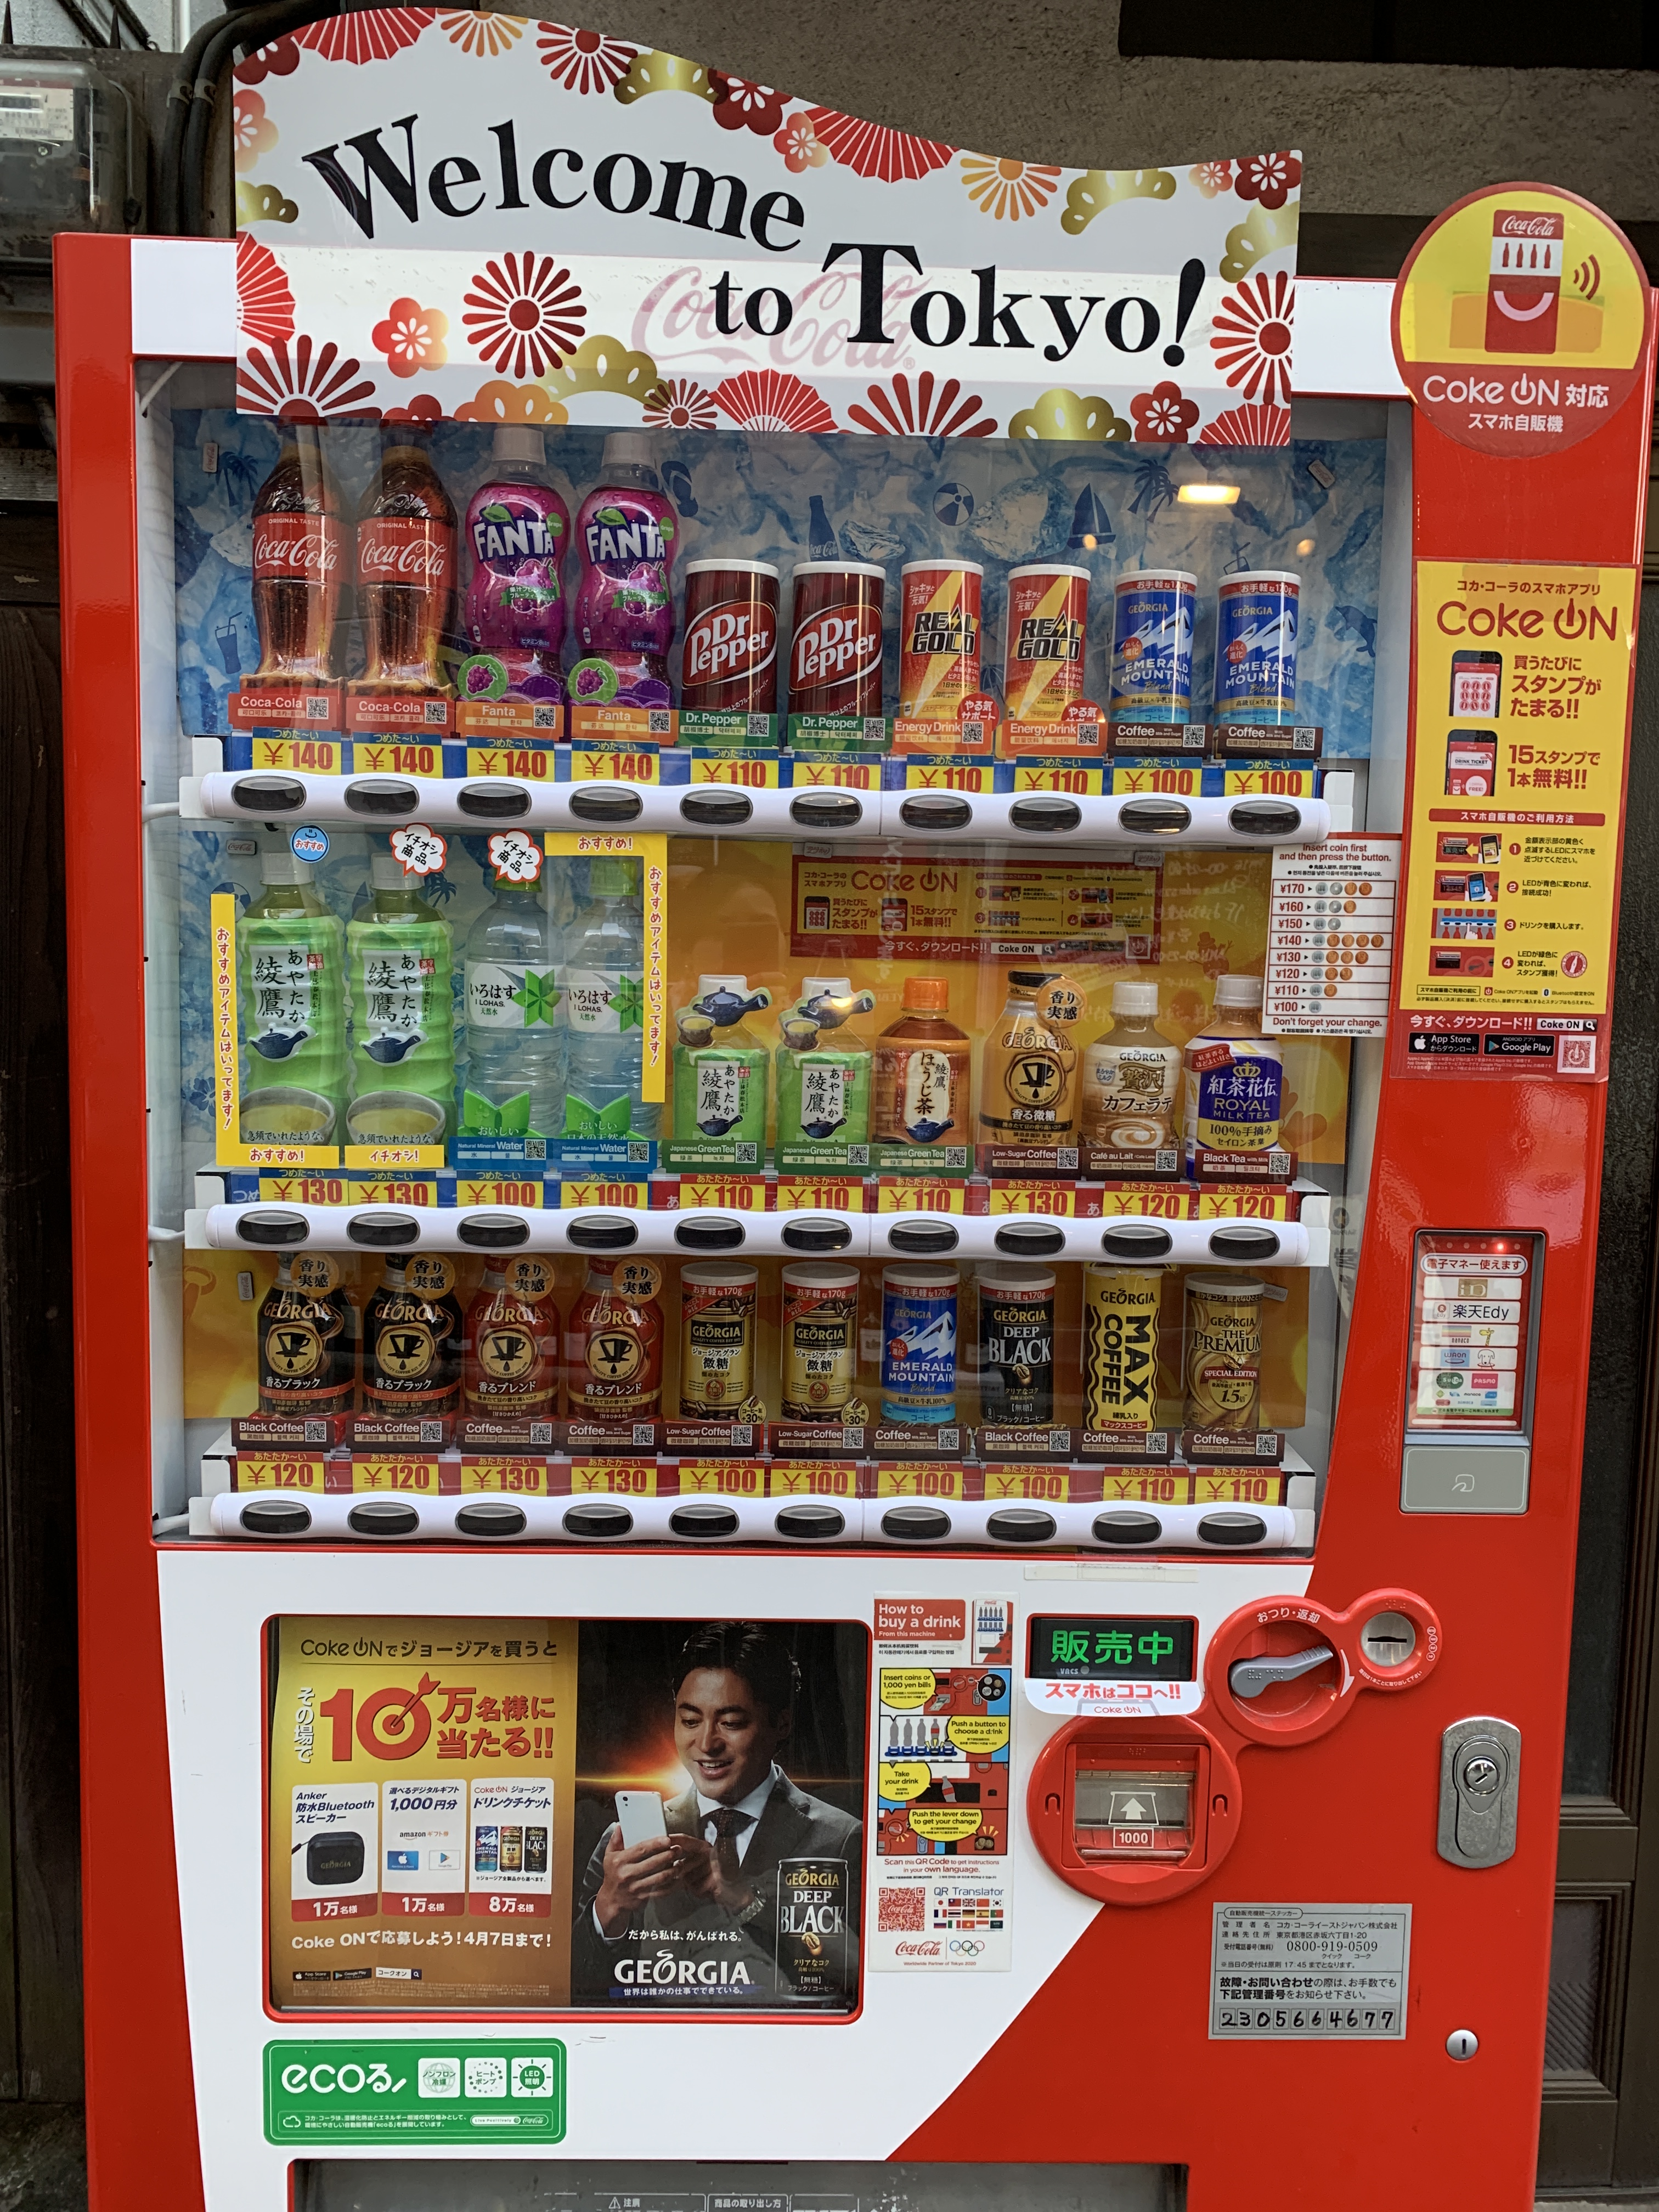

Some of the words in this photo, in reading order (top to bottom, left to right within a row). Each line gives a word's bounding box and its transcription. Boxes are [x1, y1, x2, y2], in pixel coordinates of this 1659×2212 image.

[302, 114, 804, 251] Welcome
[1502, 215, 1556, 236] Coca-Cola
[709, 270, 793, 336] to
[821, 243, 1205, 367] Tokyo!
[1423, 375, 1504, 403] Coke
[1511, 373, 1559, 405] ON
[1565, 385, 1609, 408] 対応
[1468, 414, 1563, 433] スマホ自販機
[474, 520, 554, 558] FANTA
[255, 533, 340, 571] Coca-Cola
[1457, 580, 1600, 595] コカ・コーラのスマホアプリ
[1128, 601, 1168, 614] GEORGIA
[710, 613, 749, 639] Dr
[915, 605, 977, 634] REAL
[1437, 601, 1544, 638] Coke
[1554, 598, 1617, 641] ON
[912, 632, 974, 656] GOLD
[690, 627, 769, 678] Pepper
[1125, 659, 1189, 674] EMERALD
[1514, 656, 1581, 671] 買うたびに
[1121, 673, 1190, 687] MOUNTAIN
[1511, 675, 1601, 695] スタンプが
[241, 696, 302, 709] Coca-Cola
[359, 701, 420, 713] Coca-Cola
[1510, 698, 1579, 719] たまる!!
[482, 706, 516, 716] Fanta
[895, 721, 932, 733] Energy
[934, 722, 961, 732] Drink
[1118, 726, 1155, 736] Coffee
[1509, 745, 1600, 766] 15スタンプで
[1507, 769, 1587, 789] 1本無料!!
[1460, 811, 1574, 823] スマホ自販機のご利用方法
[295, 839, 324, 852] おすすめ
[578, 836, 633, 851] おすすめ!
[1303, 843, 1327, 851] Insert
[1350, 844, 1367, 852] first
[1319, 854, 1344, 862] press
[1524, 847, 1595, 855] 点滅するLEDにスマホを
[1524, 856, 1579, 864] 近づけてください。
[1280, 884, 1305, 894] ¥170
[1279, 902, 1303, 912] ¥160
[1519, 922, 1584, 930] ドリンクを購入します。
[1278, 935, 1301, 945] ¥140
[1277, 952, 1300, 962] ¥130
[648, 867, 662, 1067] おすすめアイテムはいってます!
[255, 957, 286, 1018] 綾鷹
[287, 949, 306, 1023] あやたか
[1275, 986, 1299, 995] ¥110
[1050, 991, 1075, 1005] 香り
[1047, 1006, 1077, 1020] 実感
[1274, 1002, 1297, 1012] ¥100
[216, 928, 234, 1130] おすすめアイテムはいってます!
[1273, 1018, 1296, 1026] Don't
[1298, 1018, 1324, 1028] forget
[1325, 1019, 1345, 1028] your
[1347, 1019, 1382, 1028] change.
[1410, 1014, 1532, 1030] 今すぐ、ダウンロード!!
[1540, 1020, 1564, 1029] Coke
[1566, 1020, 1579, 1029] ON
[1431, 1035, 1447, 1044] App
[1430, 1044, 1477, 1053] からダウンロード
[1502, 1042, 1531, 1053] Google
[1533, 1043, 1551, 1053] Play
[915, 1051, 935, 1116] ほうじ茶
[1207, 1076, 1277, 1097] 紅茶花伝
[1102, 1095, 1172, 1113] カフェラテ
[1215, 1098, 1270, 1111] ROYAL
[1012, 1109, 1056, 1121] 香る微糖
[1214, 1110, 1246, 1120] MILK
[1249, 1111, 1270, 1119] TEA
[1209, 1123, 1272, 1137] 100%手摘み
[496, 1141, 523, 1150] Water
[370, 1149, 419, 1163] イチオシ!
[1427, 1259, 1521, 1271] 電子マネー使えます
[693, 1285, 742, 1296] お手軽な170g
[1101, 1288, 1155, 1305] GEORGIA
[1459, 1284, 1486, 1297] iD
[994, 1307, 1046, 1322] GEORGIA
[1452, 1304, 1509, 1321] 楽天Edy
[692, 1323, 741, 1338] GEORGIA
[1003, 1327, 1040, 1339] DEEP
[1222, 1330, 1245, 1340] THE
[1193, 1330, 1261, 1353] PREMIUM
[988, 1337, 1052, 1365] BLACK
[703, 1358, 729, 1370] 微糖
[1102, 1313, 1123, 1406] COFFEE
[1123, 1315, 1150, 1407] MAX
[1204, 1369, 1233, 1378] SPECIAL
[1234, 1369, 1257, 1378] EDITION
[266, 1376, 320, 1389] 香るブラック
[479, 1381, 536, 1393] 香るブレンド
[239, 1421, 267, 1432] Black
[269, 1421, 304, 1432] Coffee
[1103, 1420, 1147, 1429] マックスコーヒー
[879, 1604, 908, 1614] How
[910, 1605, 923, 1614] to
[1256, 1608, 1321, 1624] おつり・返却
[879, 1616, 906, 1629] buy
[911, 1618, 919, 1627] a
[921, 1616, 961, 1628] drink
[301, 1639, 349, 1657] Coke
[1051, 1629, 1173, 1665] 販売中
[1045, 1683, 1181, 1700] スマホはココへ!!
[437, 1688, 555, 1723] 万名様に
[294, 1687, 315, 1763] その場で
[437, 1728, 553, 1760] 当たる!!
[296, 1791, 327, 1801] Anker
[473, 1797, 551, 1809] ドリンクチケット
[296, 1800, 375, 1813] 防水Bluetooth
[296, 1813, 347, 1824] スピーカー
[1119, 1832, 1149, 1845] 1000
[934, 1887, 949, 1896] QR
[952, 1887, 1004, 1896] Translator
[313, 1900, 358, 1917] 1万名様
[489, 1896, 534, 1914] 8万名様
[628, 1929, 745, 1943] だから私は、がんばれる。
[895, 1941, 943, 1956] Coca-Cola
[1287, 1941, 1378, 1953] 0800-919-0509
[614, 1949, 751, 1985] GEORGIA
[623, 1987, 745, 1997] 世界は誰かの仕事でできている。
[1220, 1989, 1367, 2000] 下記管理番号をお知らせ下さい。
